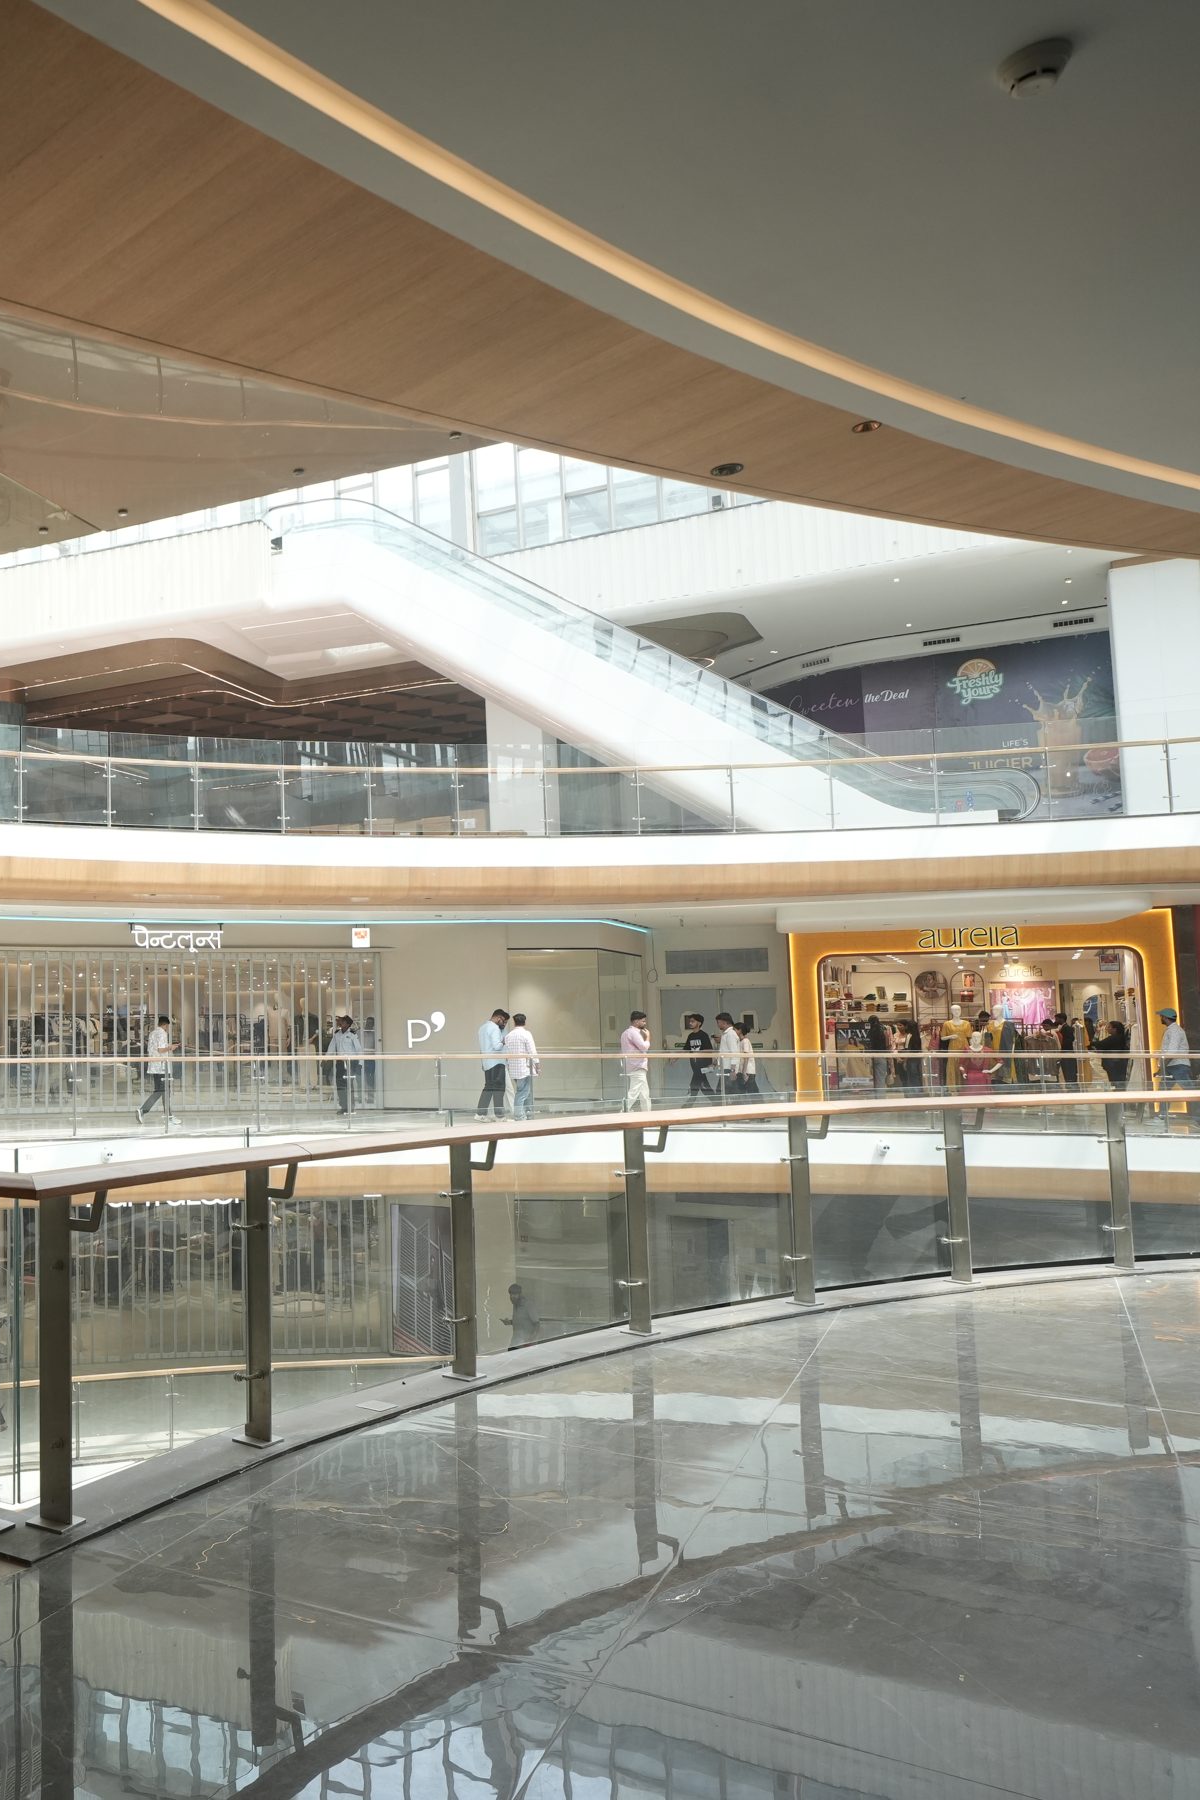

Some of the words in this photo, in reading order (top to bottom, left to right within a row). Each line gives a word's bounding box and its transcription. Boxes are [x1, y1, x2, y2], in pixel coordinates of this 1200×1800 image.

[947, 669, 1004, 694] Freshly
[864, 693, 881, 704] the
[880, 689, 910, 702] Deal
[961, 684, 1001, 705] yours
[1002, 738, 1029, 748] LIFE'S
